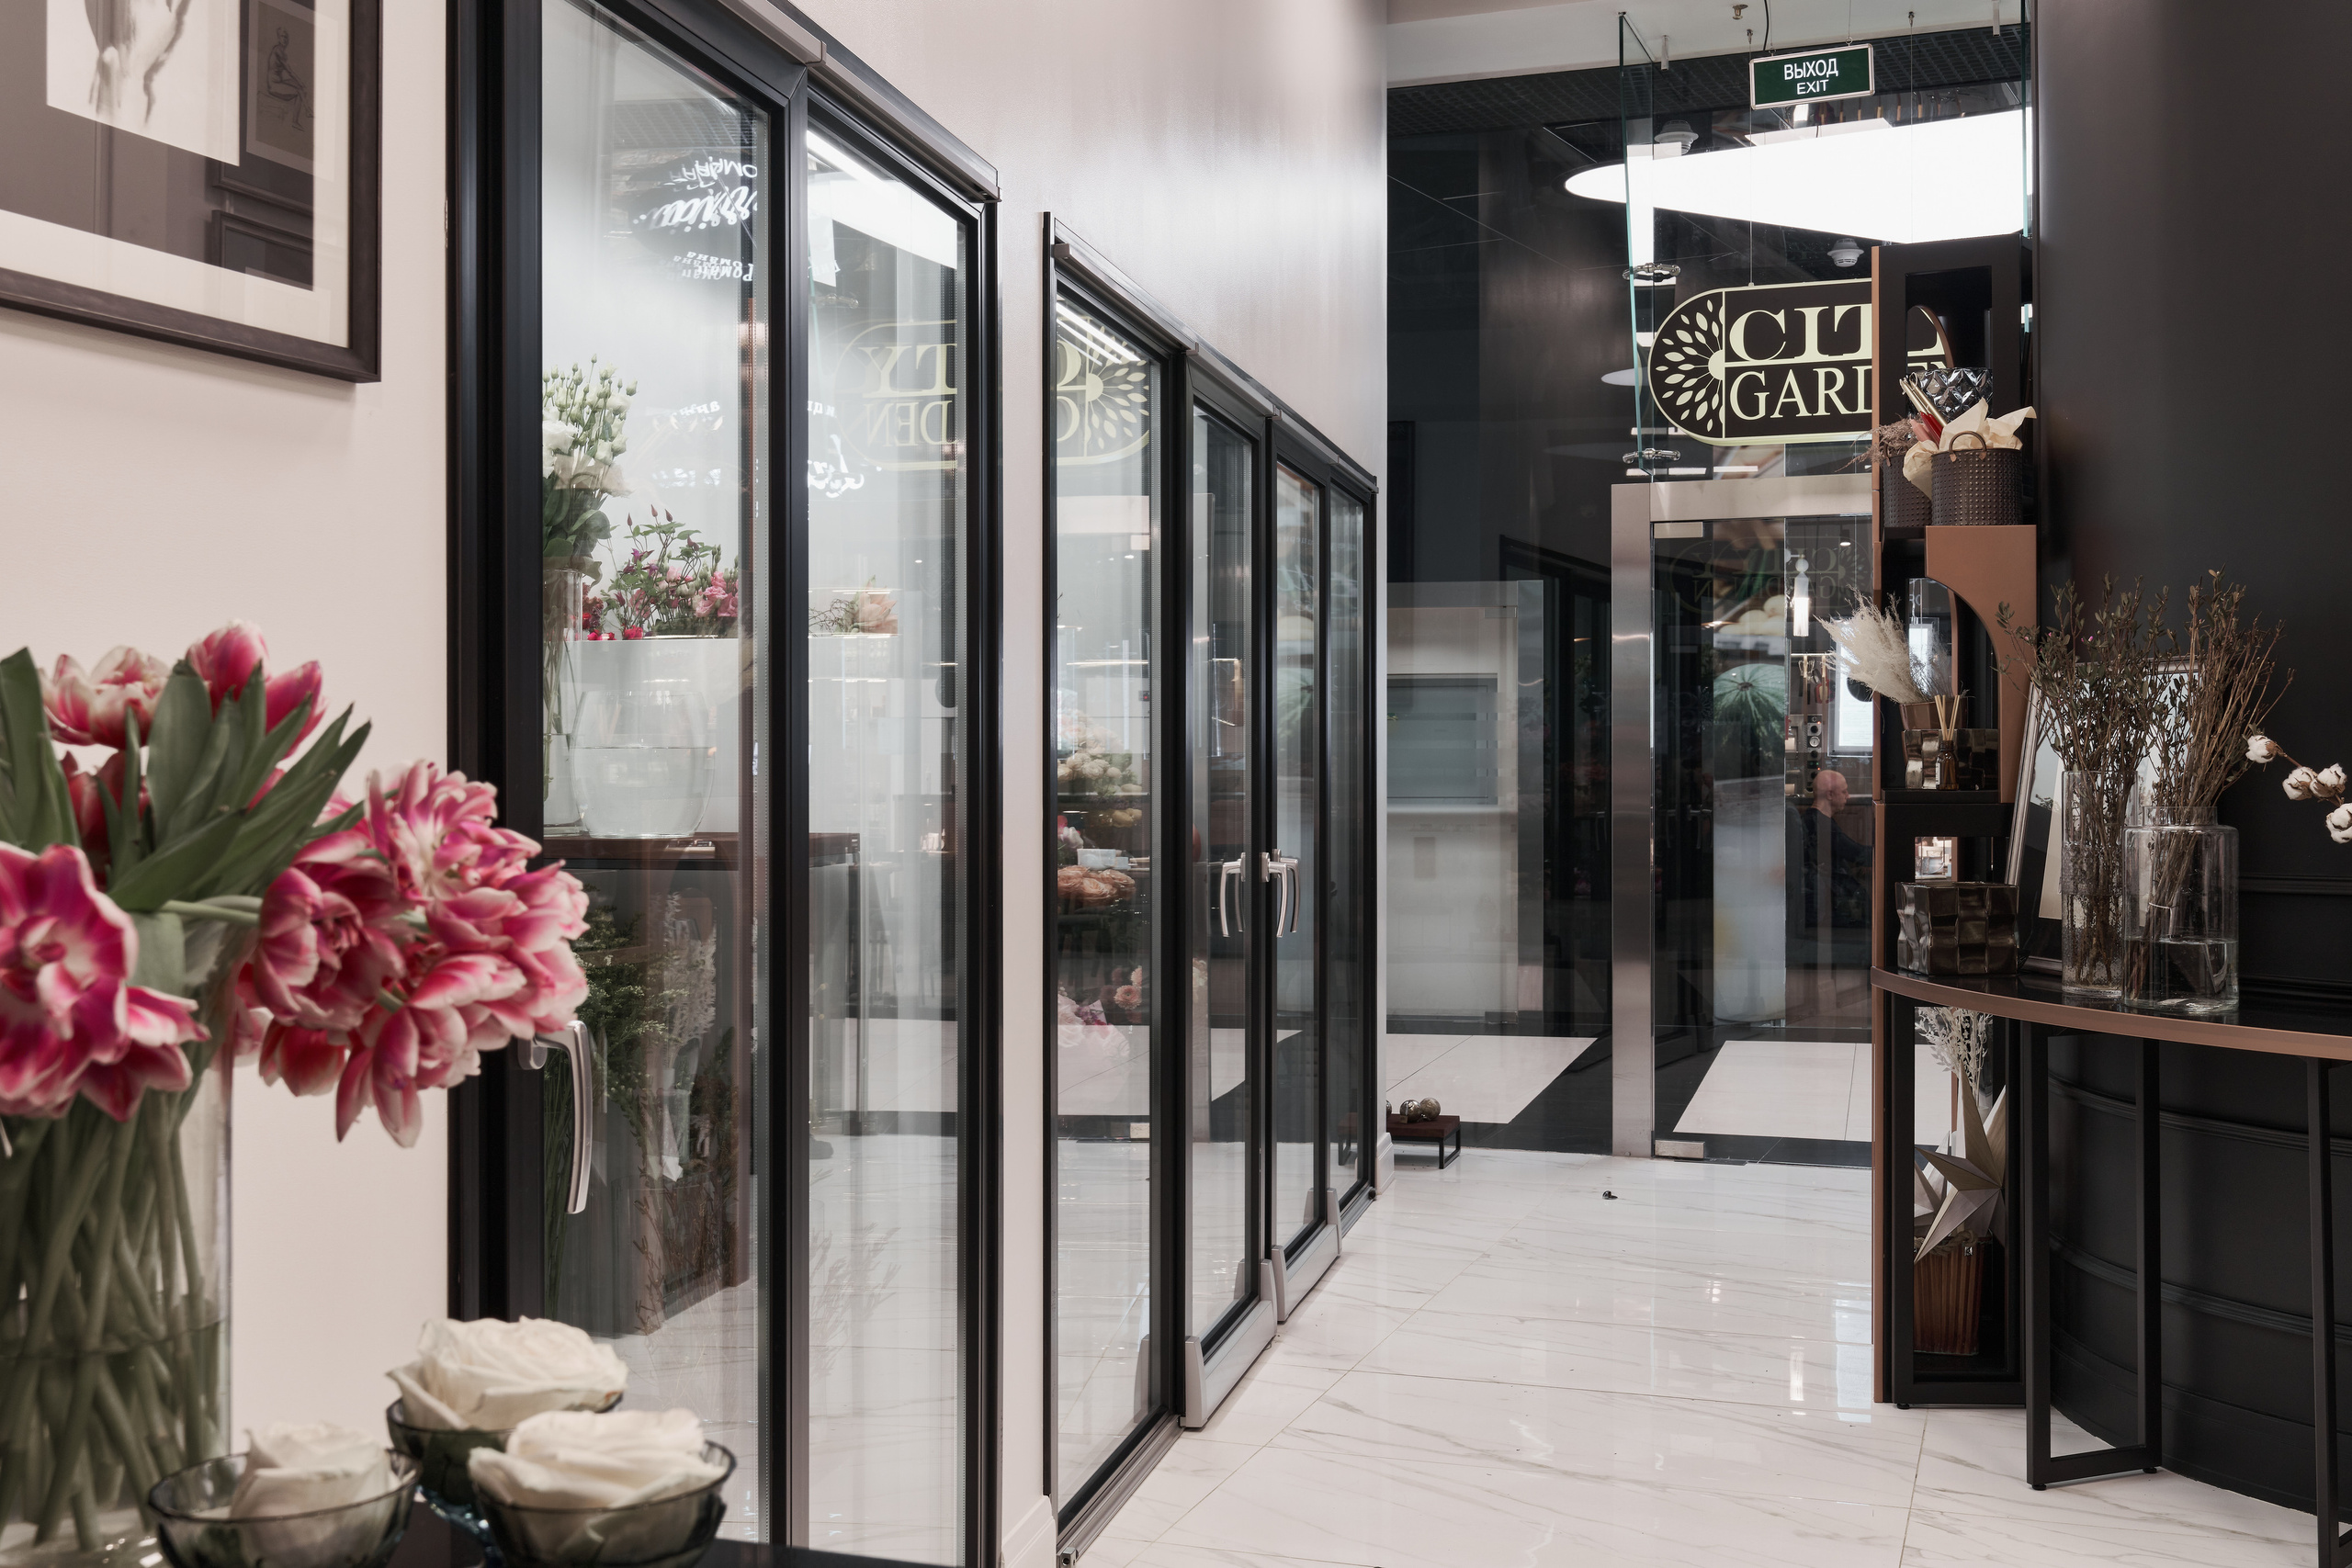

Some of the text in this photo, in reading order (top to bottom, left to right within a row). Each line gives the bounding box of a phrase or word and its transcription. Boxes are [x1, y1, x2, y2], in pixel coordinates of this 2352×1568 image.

[1783, 58, 1838, 80] ВЫХОД
[1796, 79, 1829, 95] EXIT
[1729, 303, 1945, 361] CIT
[1729, 361, 1946, 421] GARD
